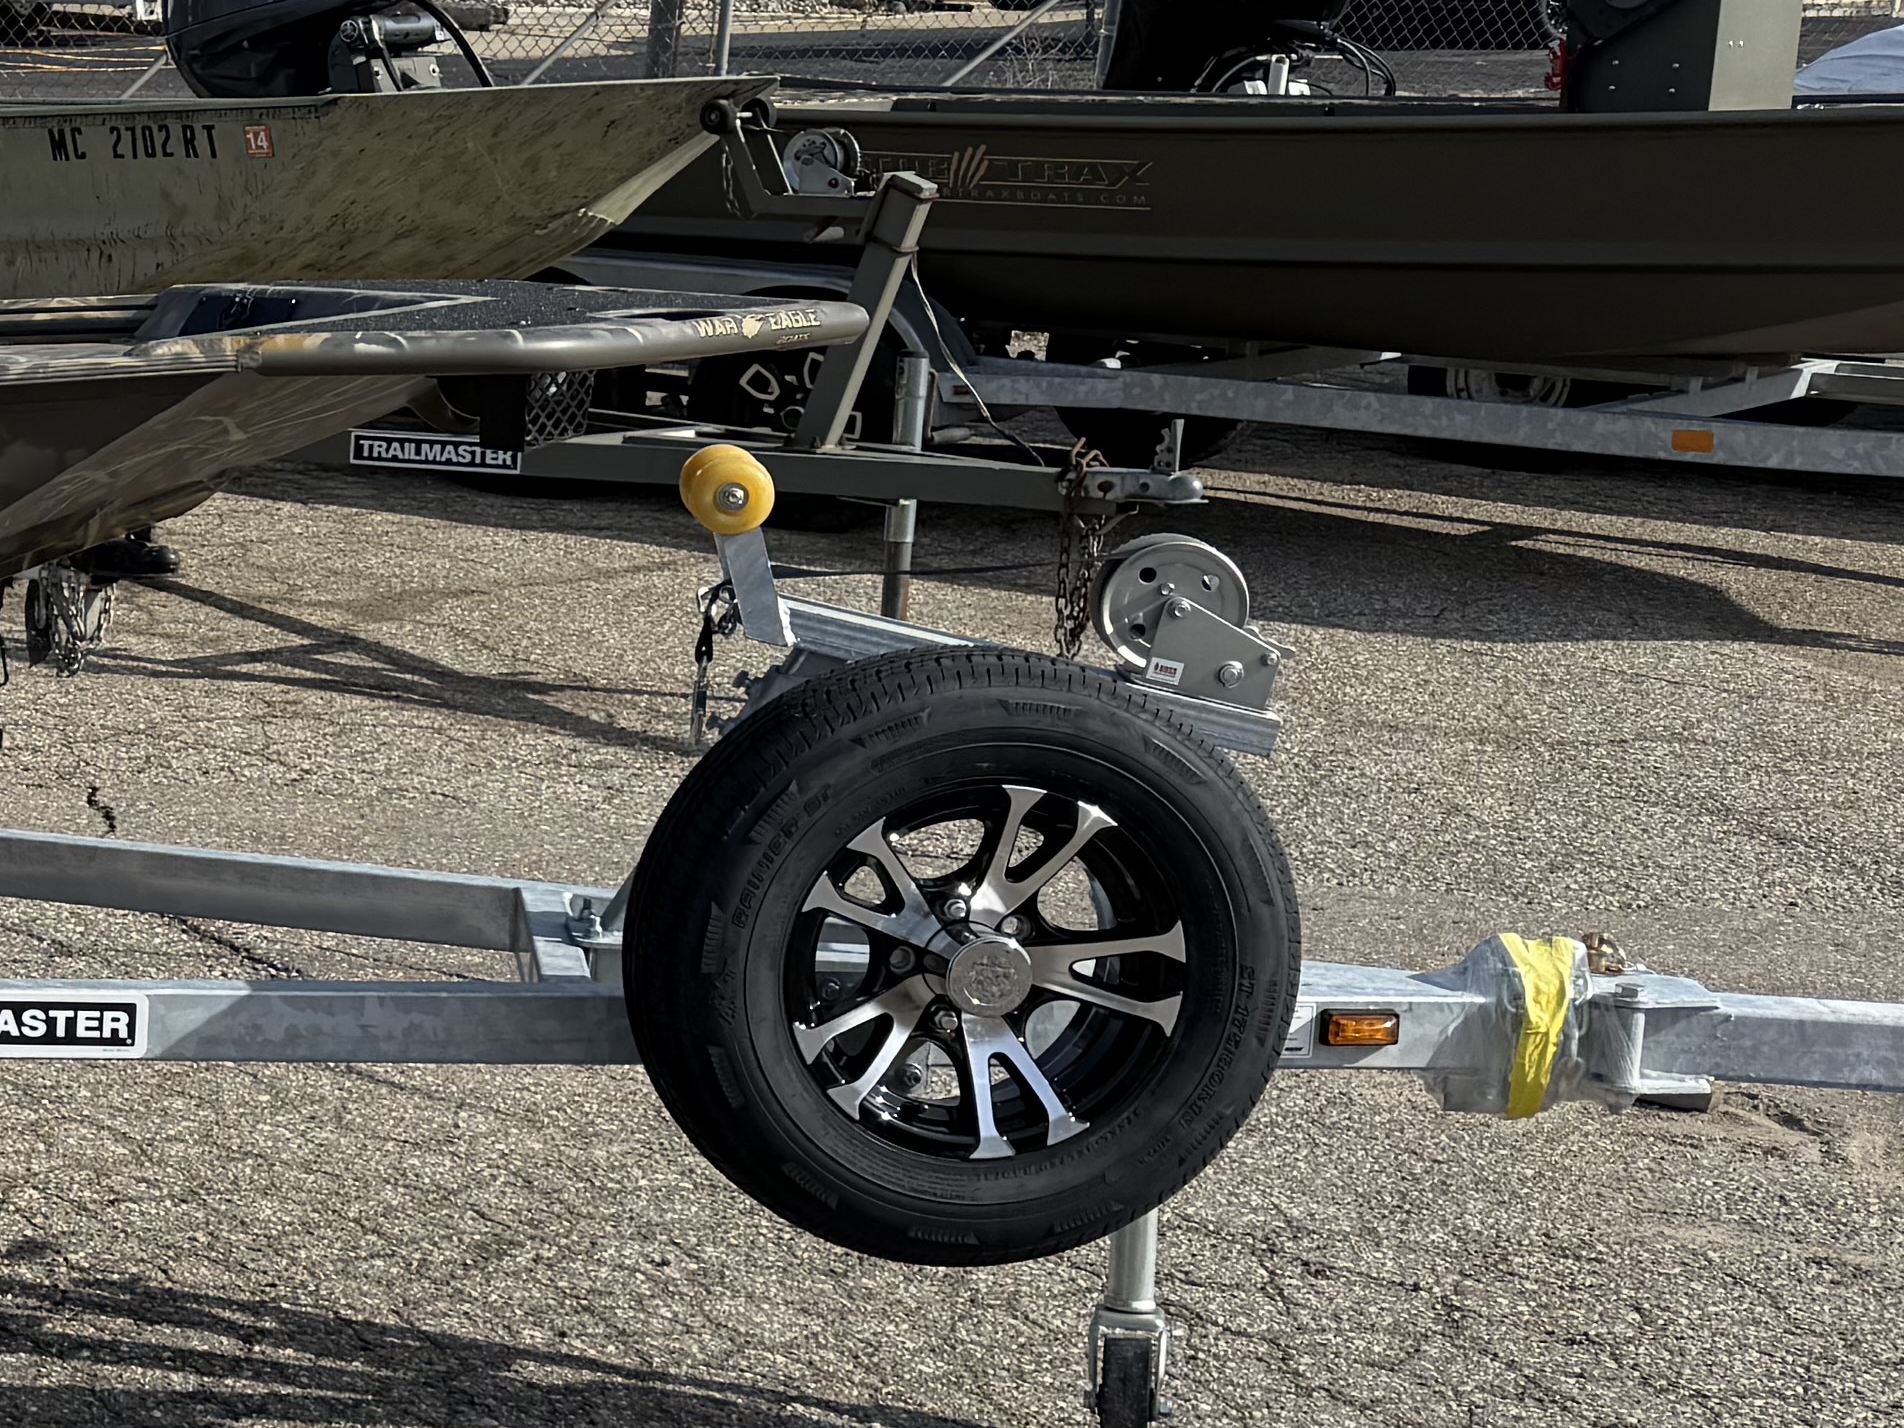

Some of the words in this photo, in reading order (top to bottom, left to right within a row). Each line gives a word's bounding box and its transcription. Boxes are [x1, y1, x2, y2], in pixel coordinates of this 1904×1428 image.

[47, 126, 87, 162] MC
[109, 124, 175, 160] 2702
[181, 123, 218, 160] RT
[246, 131, 269, 150] 14
[693, 317, 739, 338] WAR
[765, 309, 822, 330] EAGLE
[358, 439, 513, 467] TRAILMASTER
